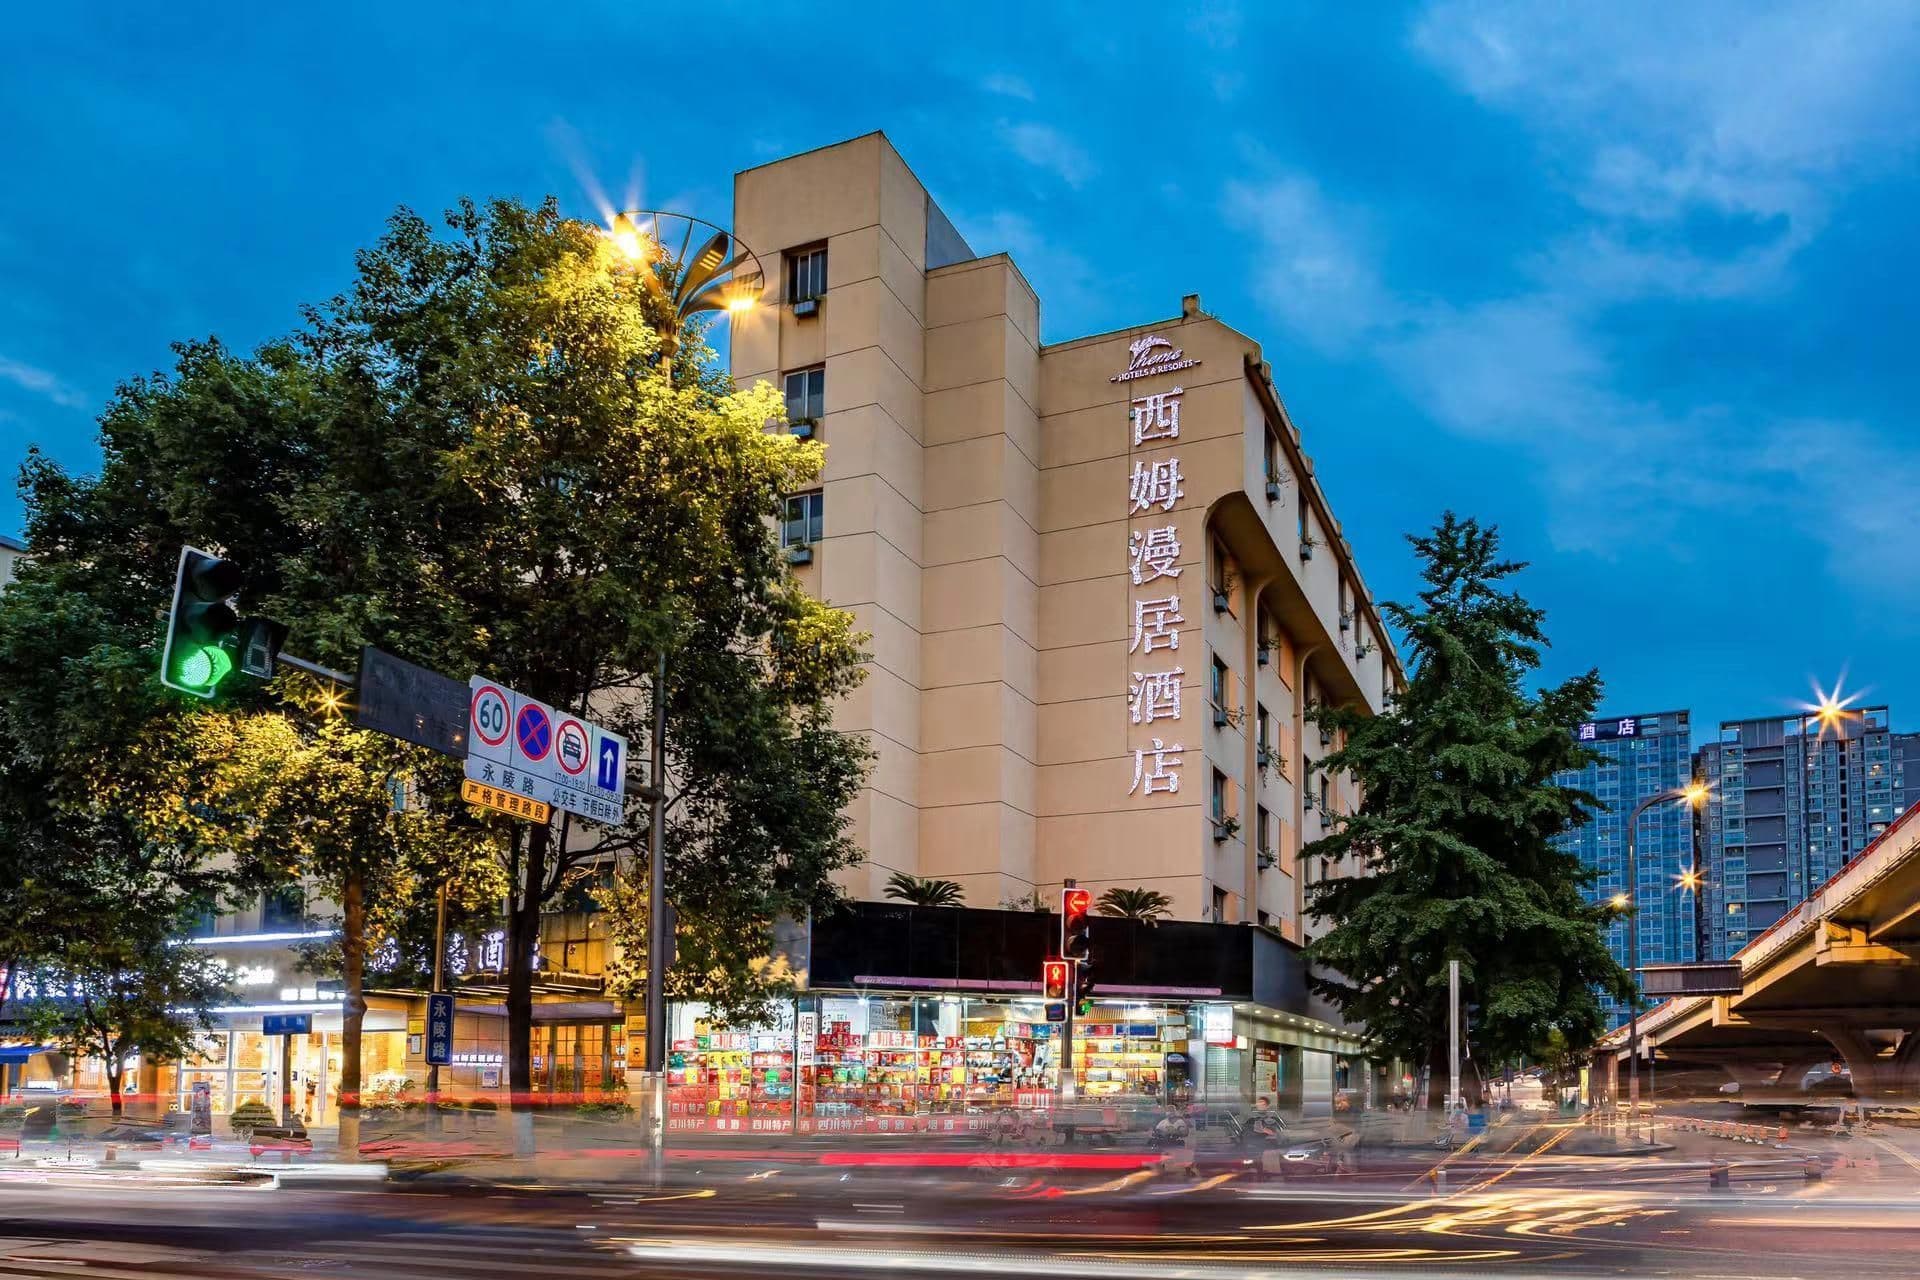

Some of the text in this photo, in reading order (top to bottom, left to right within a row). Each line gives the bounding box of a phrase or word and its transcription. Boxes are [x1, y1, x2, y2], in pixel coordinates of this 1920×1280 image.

[1118, 359, 1194, 382] HOTELS & RESORTS
[1128, 385, 1185, 796] 西姆漫居酒店
[480, 699, 503, 733] 60
[1579, 718, 1635, 740] 酒店
[483, 763, 535, 796] 永陵路
[467, 784, 545, 820] 严格管理路段
[553, 788, 577, 809] 公交车
[432, 1000, 447, 1058] 永陵路
[752, 1119, 791, 1131] 四川特产
